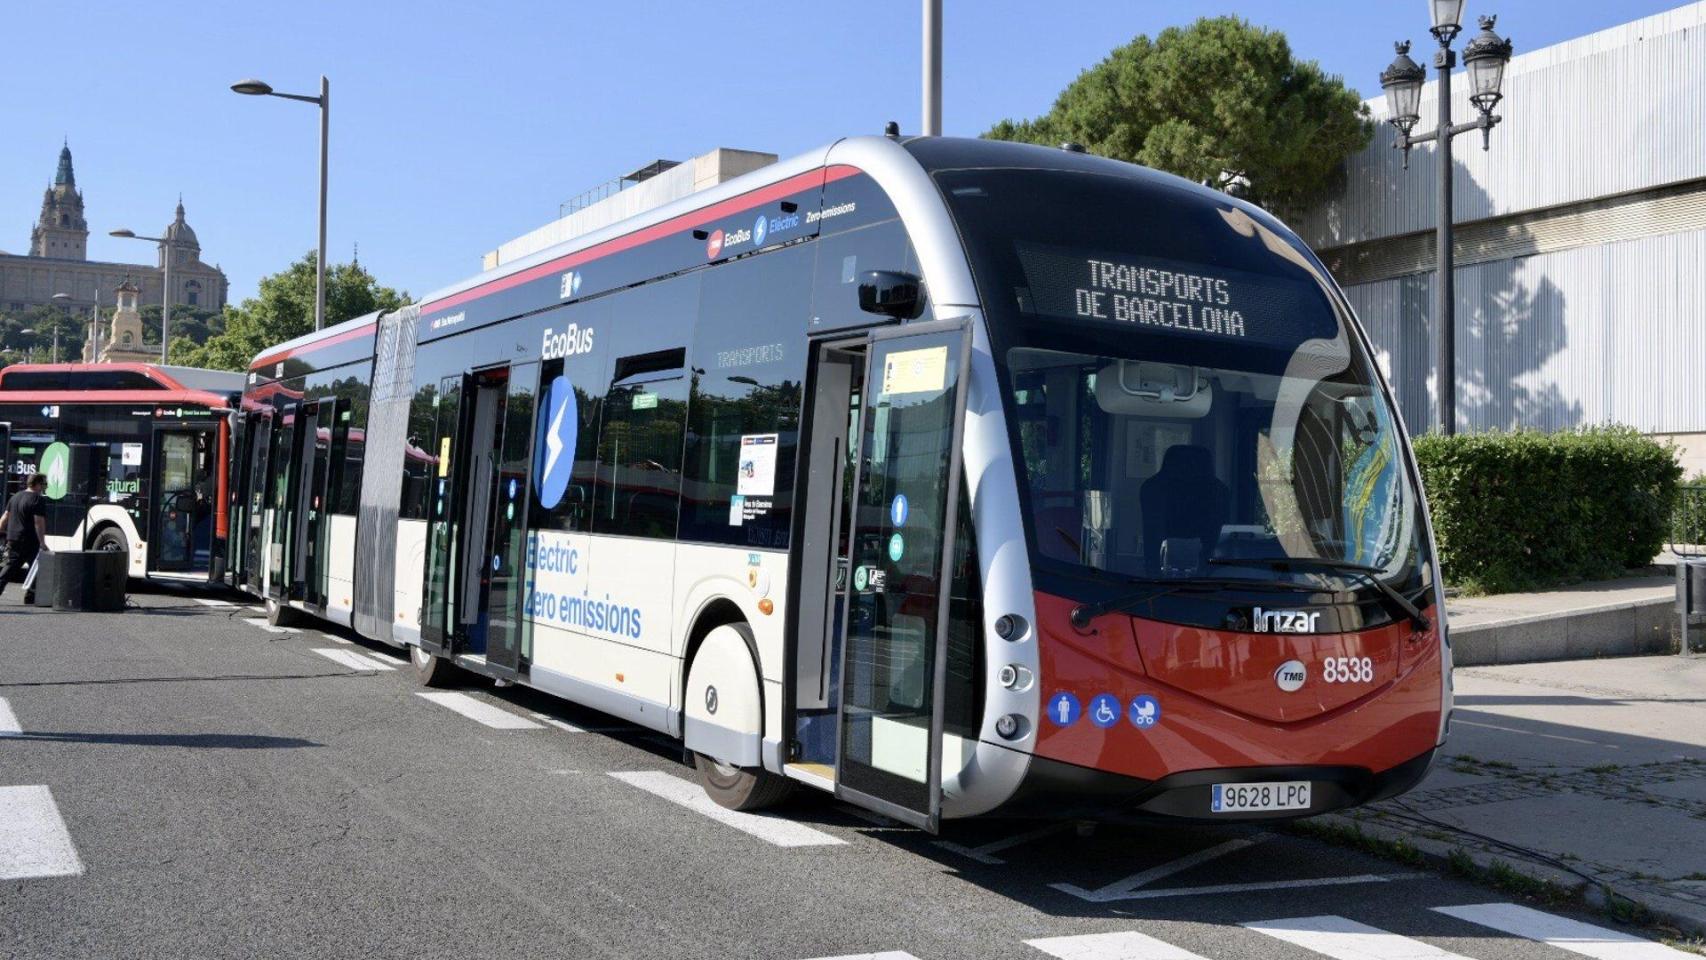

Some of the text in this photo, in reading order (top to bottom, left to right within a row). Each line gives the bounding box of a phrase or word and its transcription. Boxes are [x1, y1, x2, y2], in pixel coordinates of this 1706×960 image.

[723, 229, 751, 247] EcoBus
[769, 213, 799, 233] Elèctric
[806, 211, 821, 224] Zero
[821, 201, 856, 220] emissions
[1088, 260, 1230, 305] TRANSPORTS
[1076, 289, 1245, 336] DE BARCELONA
[542, 323, 594, 360] EcoBus
[717, 344, 784, 368] TRANSPORTS
[526, 534, 578, 574] Elèctric
[524, 581, 641, 638] Zero emissions
[1253, 607, 1320, 633] Irizar
[1283, 672, 1304, 682] TMB
[1323, 657, 1373, 683] 8538
[1225, 784, 1307, 808] 9628 LPC
